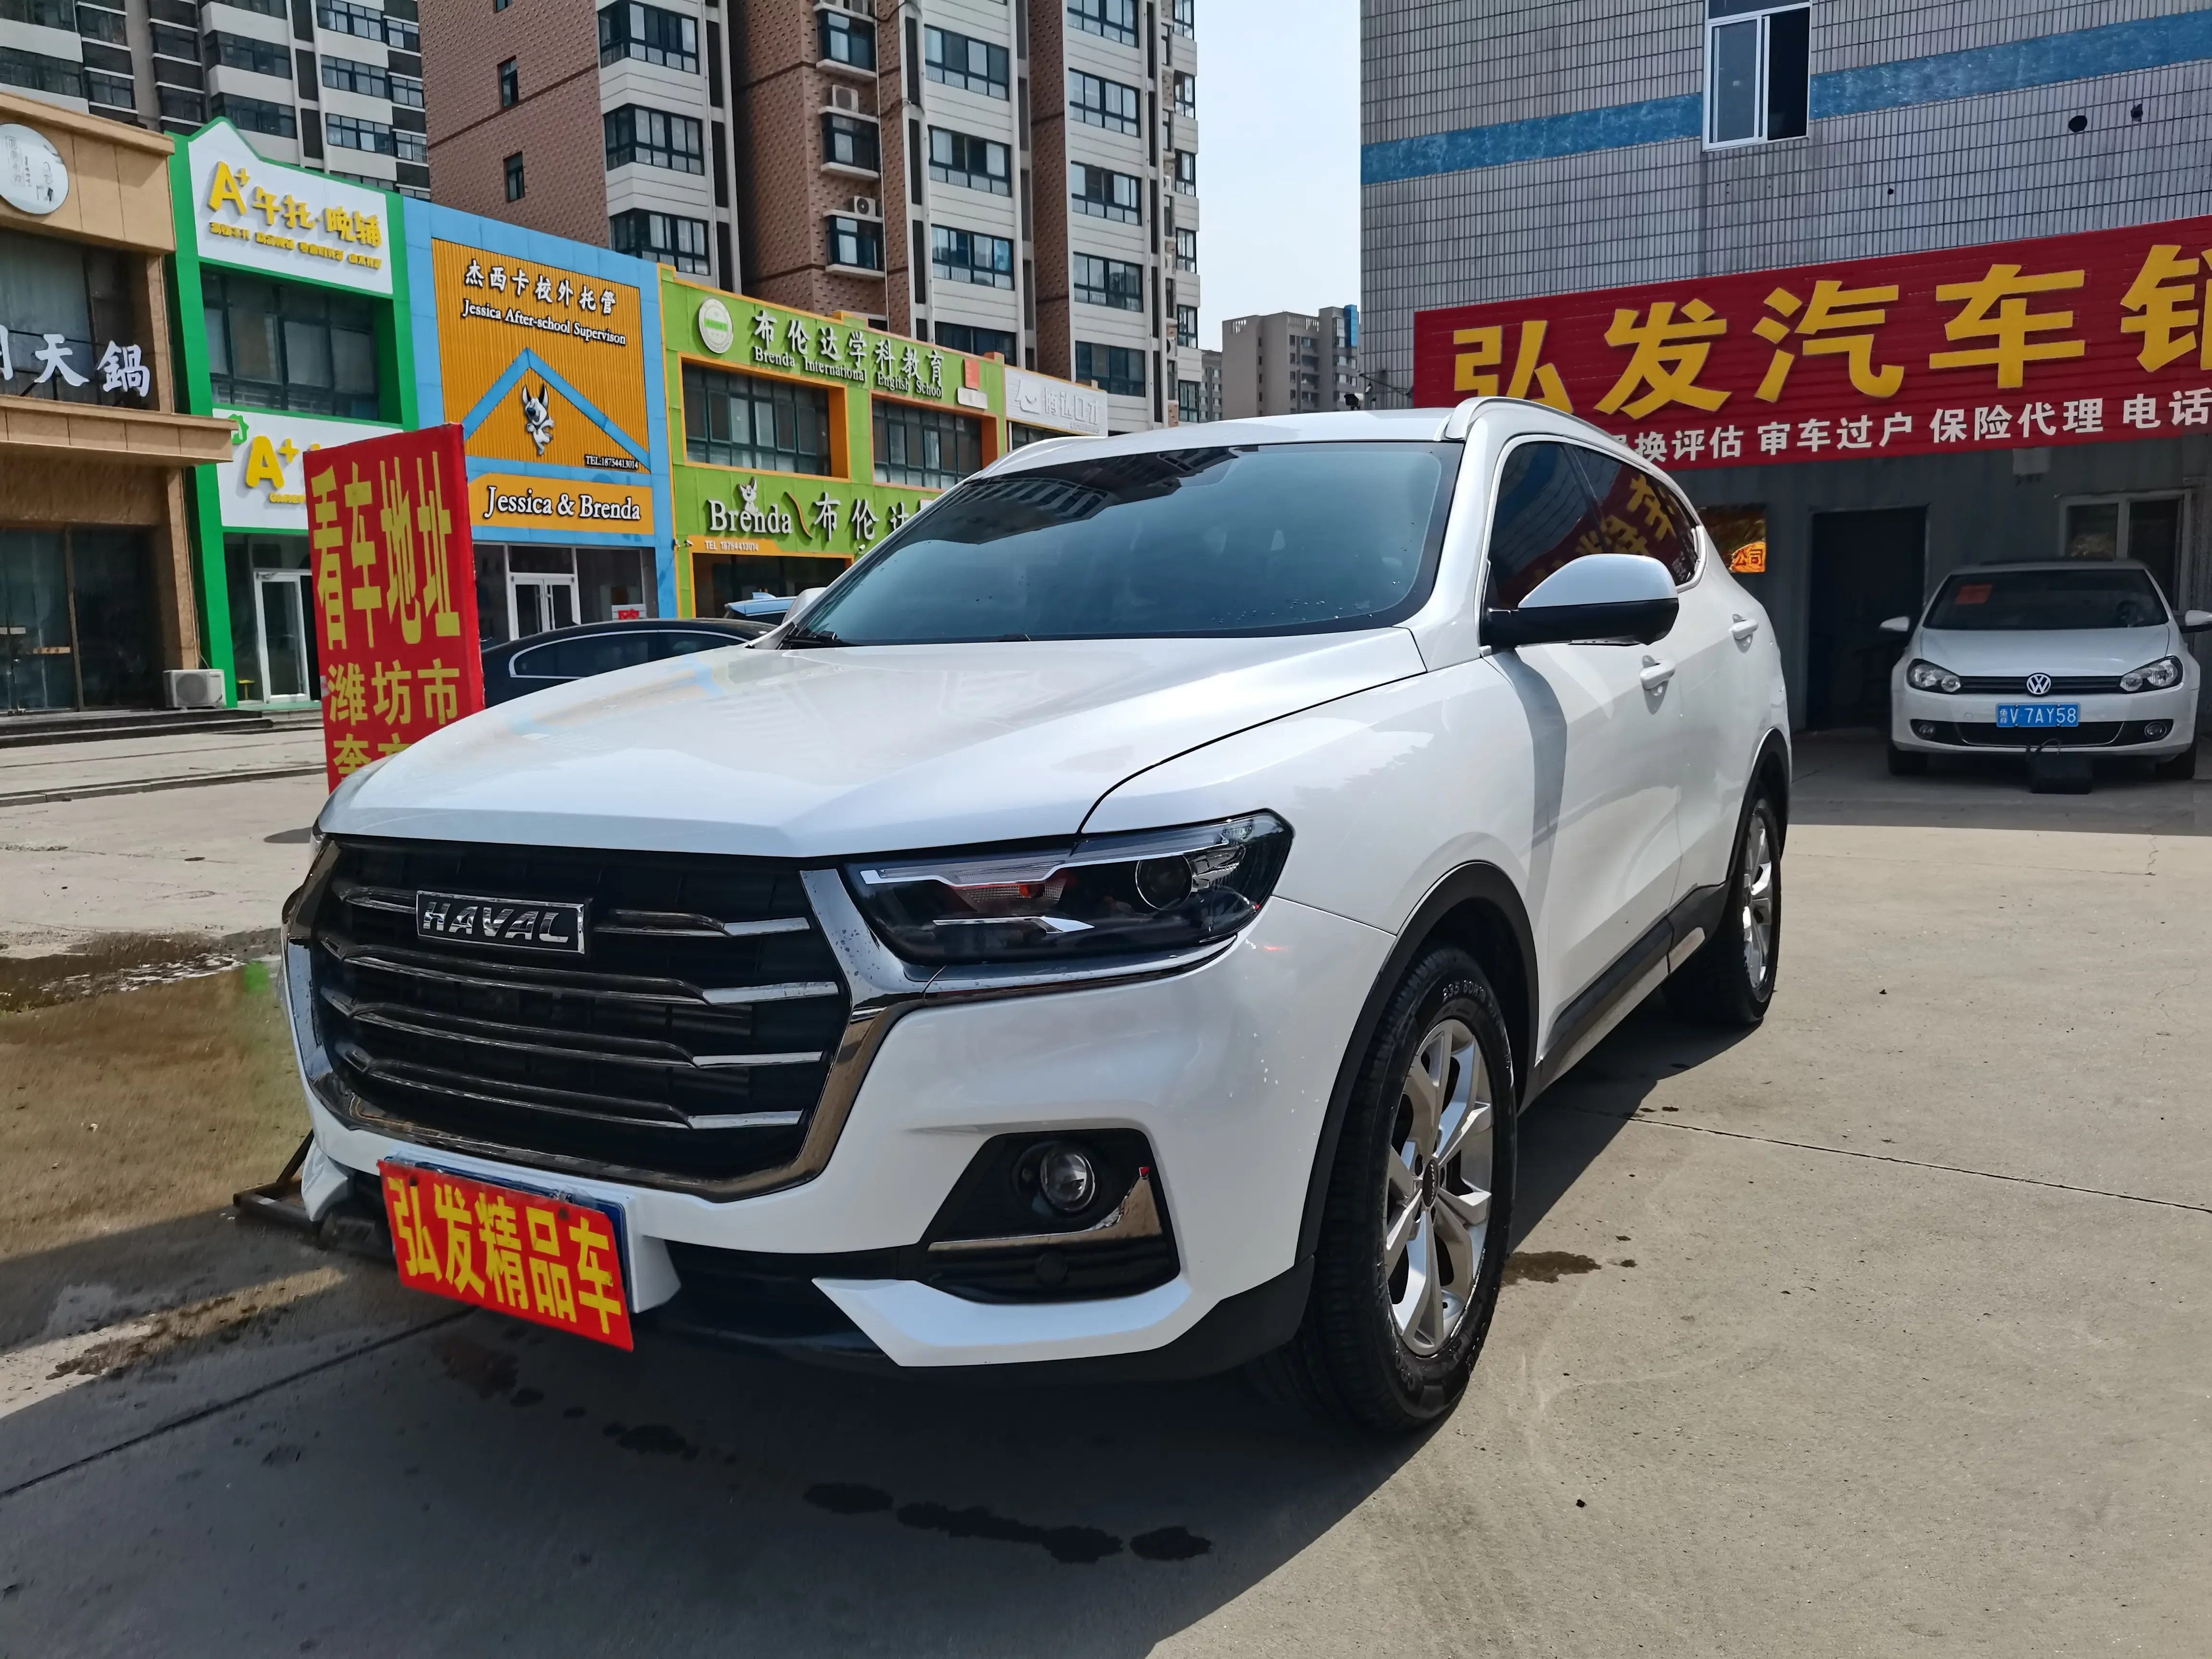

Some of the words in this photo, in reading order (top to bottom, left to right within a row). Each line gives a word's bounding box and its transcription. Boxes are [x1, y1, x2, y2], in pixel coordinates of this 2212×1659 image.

[465, 259, 616, 314] 杰西卡校外托管
[462, 300, 501, 320] Jessica
[505, 309, 570, 334] After-school
[573, 322, 626, 345] Supervison
[754, 310, 944, 386] 布伦达学科教育
[754, 346, 795, 367] Brenda
[805, 355, 866, 383] International
[877, 371, 910, 392] English
[916, 379, 943, 399] School
[1611, 430, 1741, 462] 换评估
[1757, 411, 1912, 456] 审车过户
[1929, 396, 2104, 444] 保险代理
[2122, 386, 2212, 429] 电话
[484, 486, 553, 519] Jessica
[557, 494, 575, 516] &
[579, 494, 641, 520] Brenda
[708, 499, 793, 534] Brenda
[814, 492, 910, 541] 布伦达
[311, 450, 460, 650] 看车地址
[705, 540, 717, 550] TEL
[328, 658, 459, 727] 潍坊市
[333, 732, 412, 774] 奎
[423, 901, 569, 943] HAVAL
[389, 1176, 622, 1334] 弘发精品车
